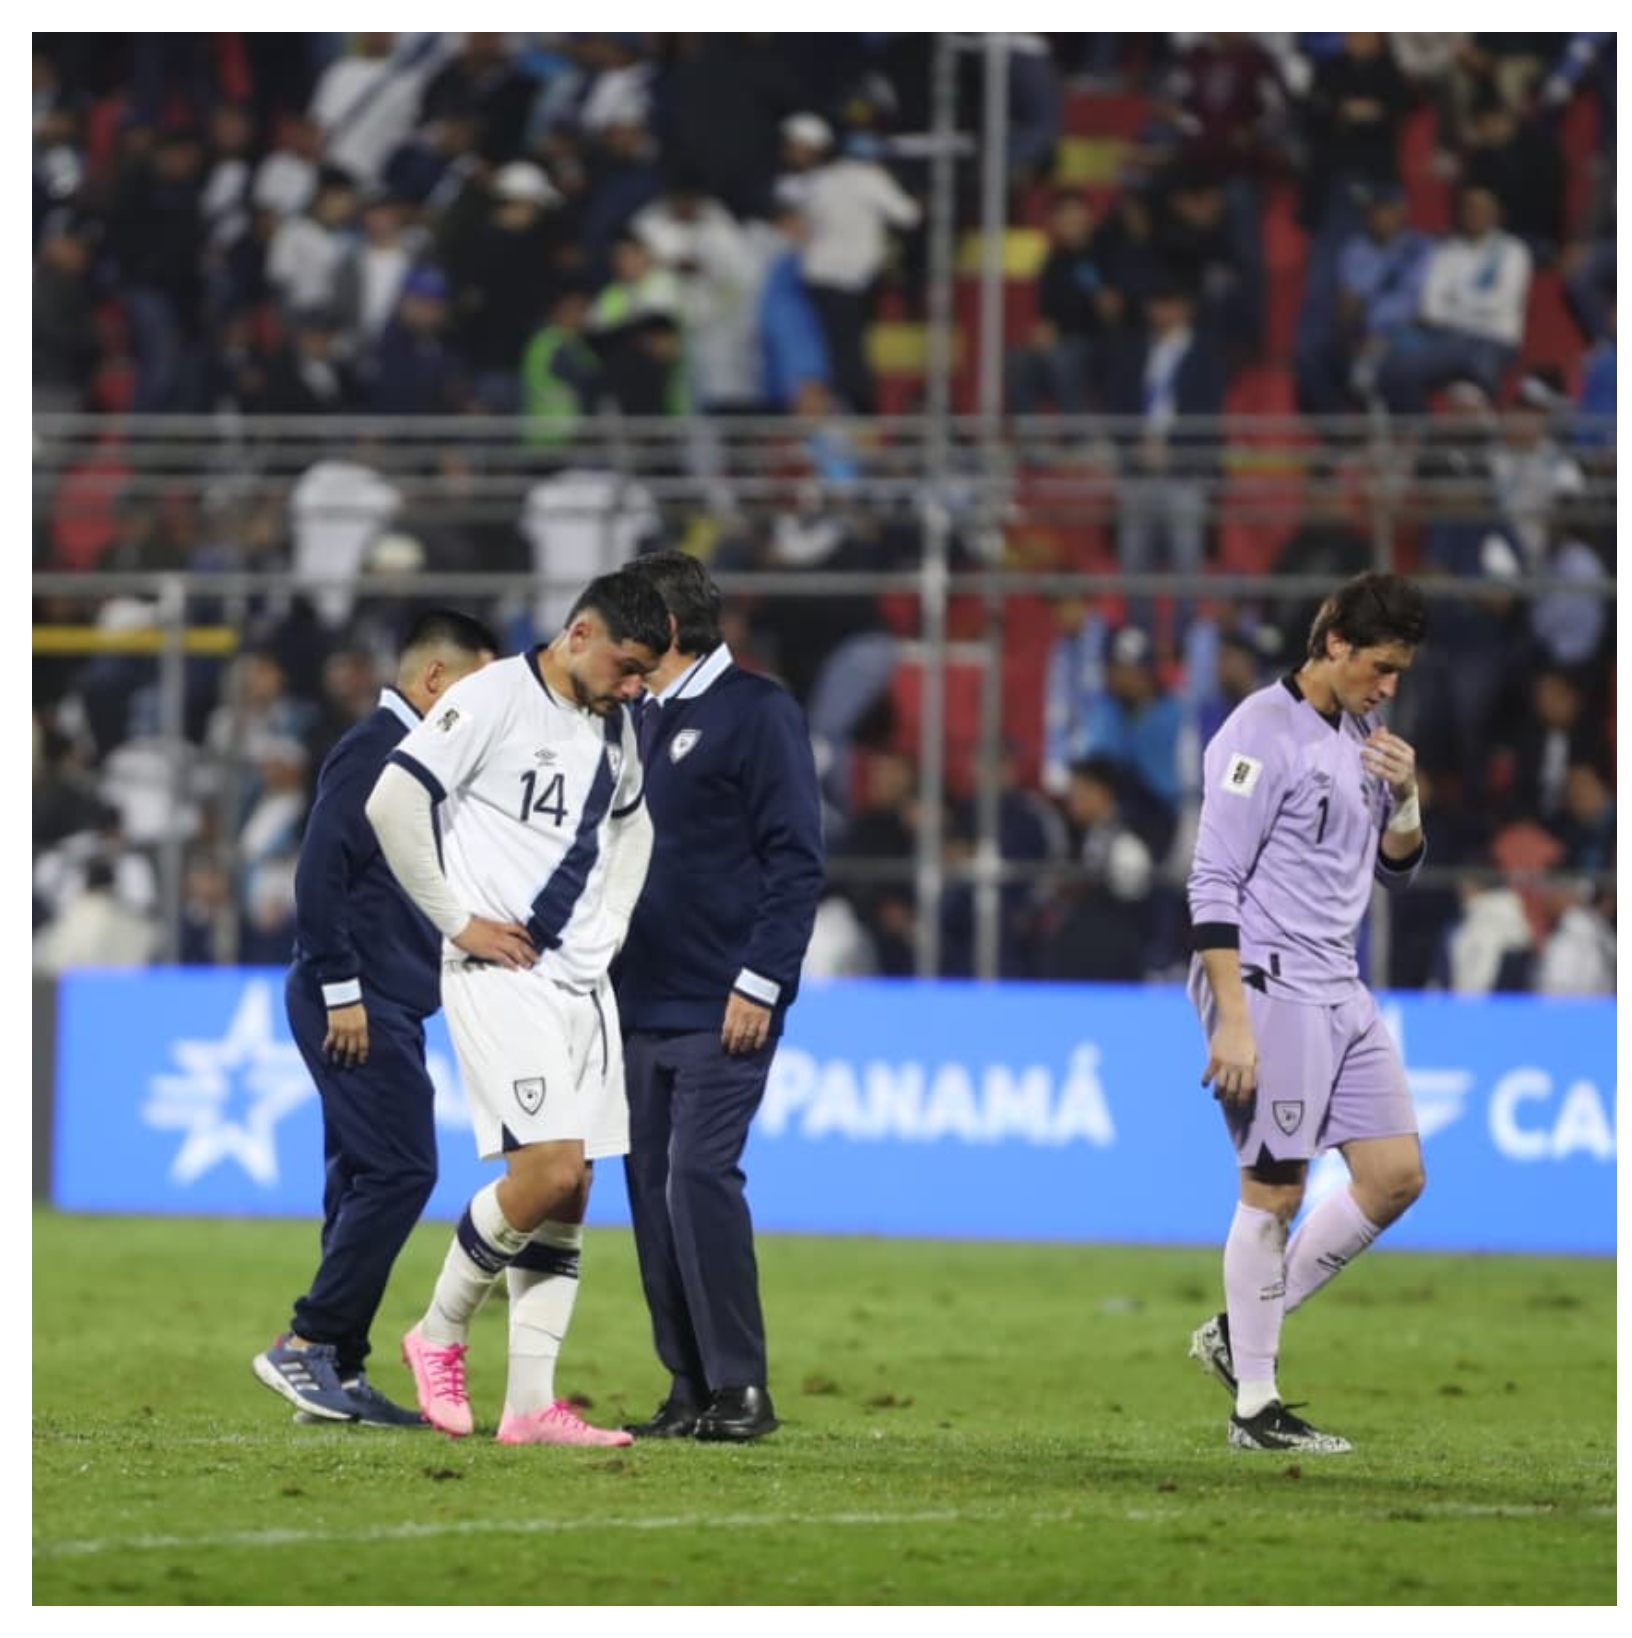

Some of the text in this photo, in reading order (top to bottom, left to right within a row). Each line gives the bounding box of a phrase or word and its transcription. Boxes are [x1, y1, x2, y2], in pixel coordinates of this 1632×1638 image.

[519, 769, 569, 828] 14
[1316, 796, 1330, 845] 1
[761, 1042, 1115, 1146] PANAMÁ
[1488, 1067, 1617, 1161] CA
